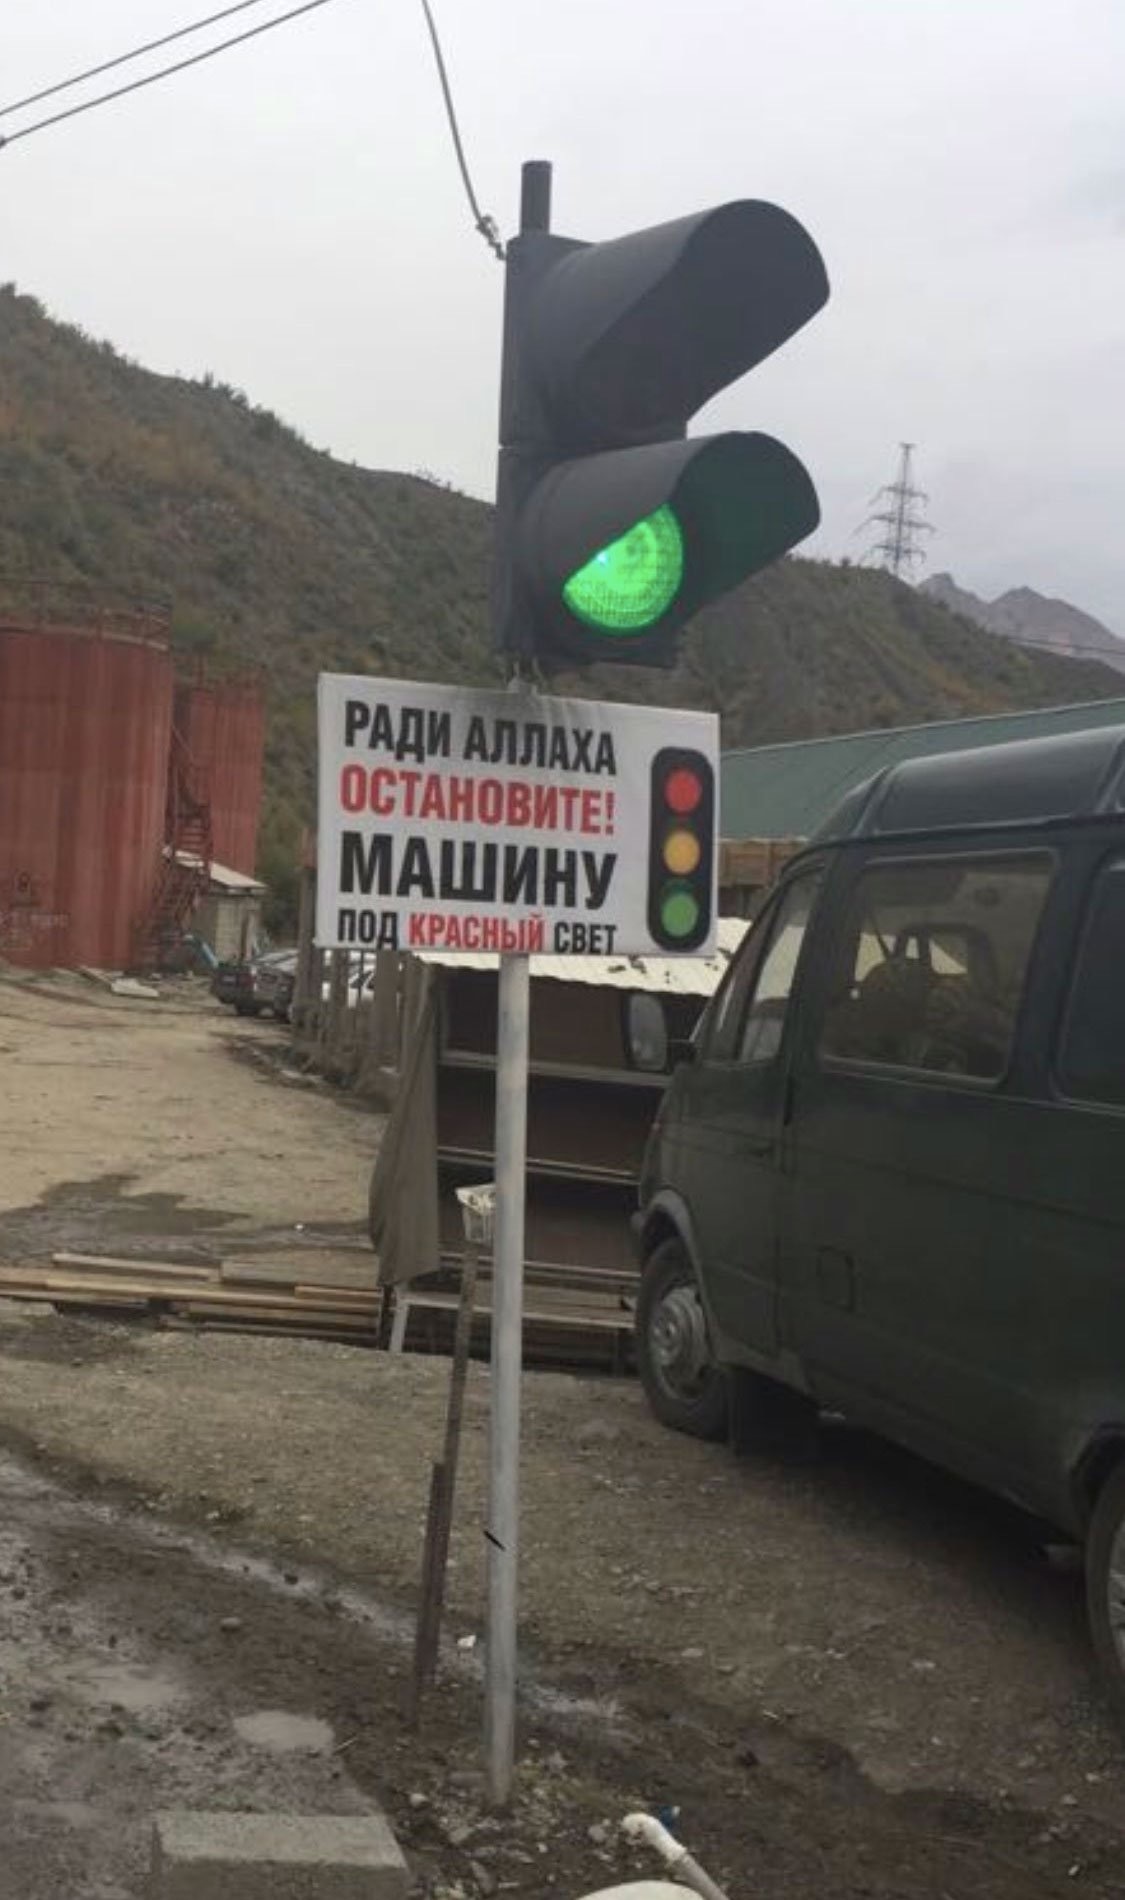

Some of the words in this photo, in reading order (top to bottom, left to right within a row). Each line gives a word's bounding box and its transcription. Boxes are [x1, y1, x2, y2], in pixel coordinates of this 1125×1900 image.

[345, 701, 451, 763] РАДИ
[463, 717, 617, 775] АЛЛАХА
[340, 765, 616, 835] ОСТАНОВИТЕ!
[340, 832, 617, 910] МАШИНУ
[337, 909, 398, 950] ПОД
[408, 912, 545, 951] КРАСНЫЙ
[554, 921, 617, 955] СВЕТ
